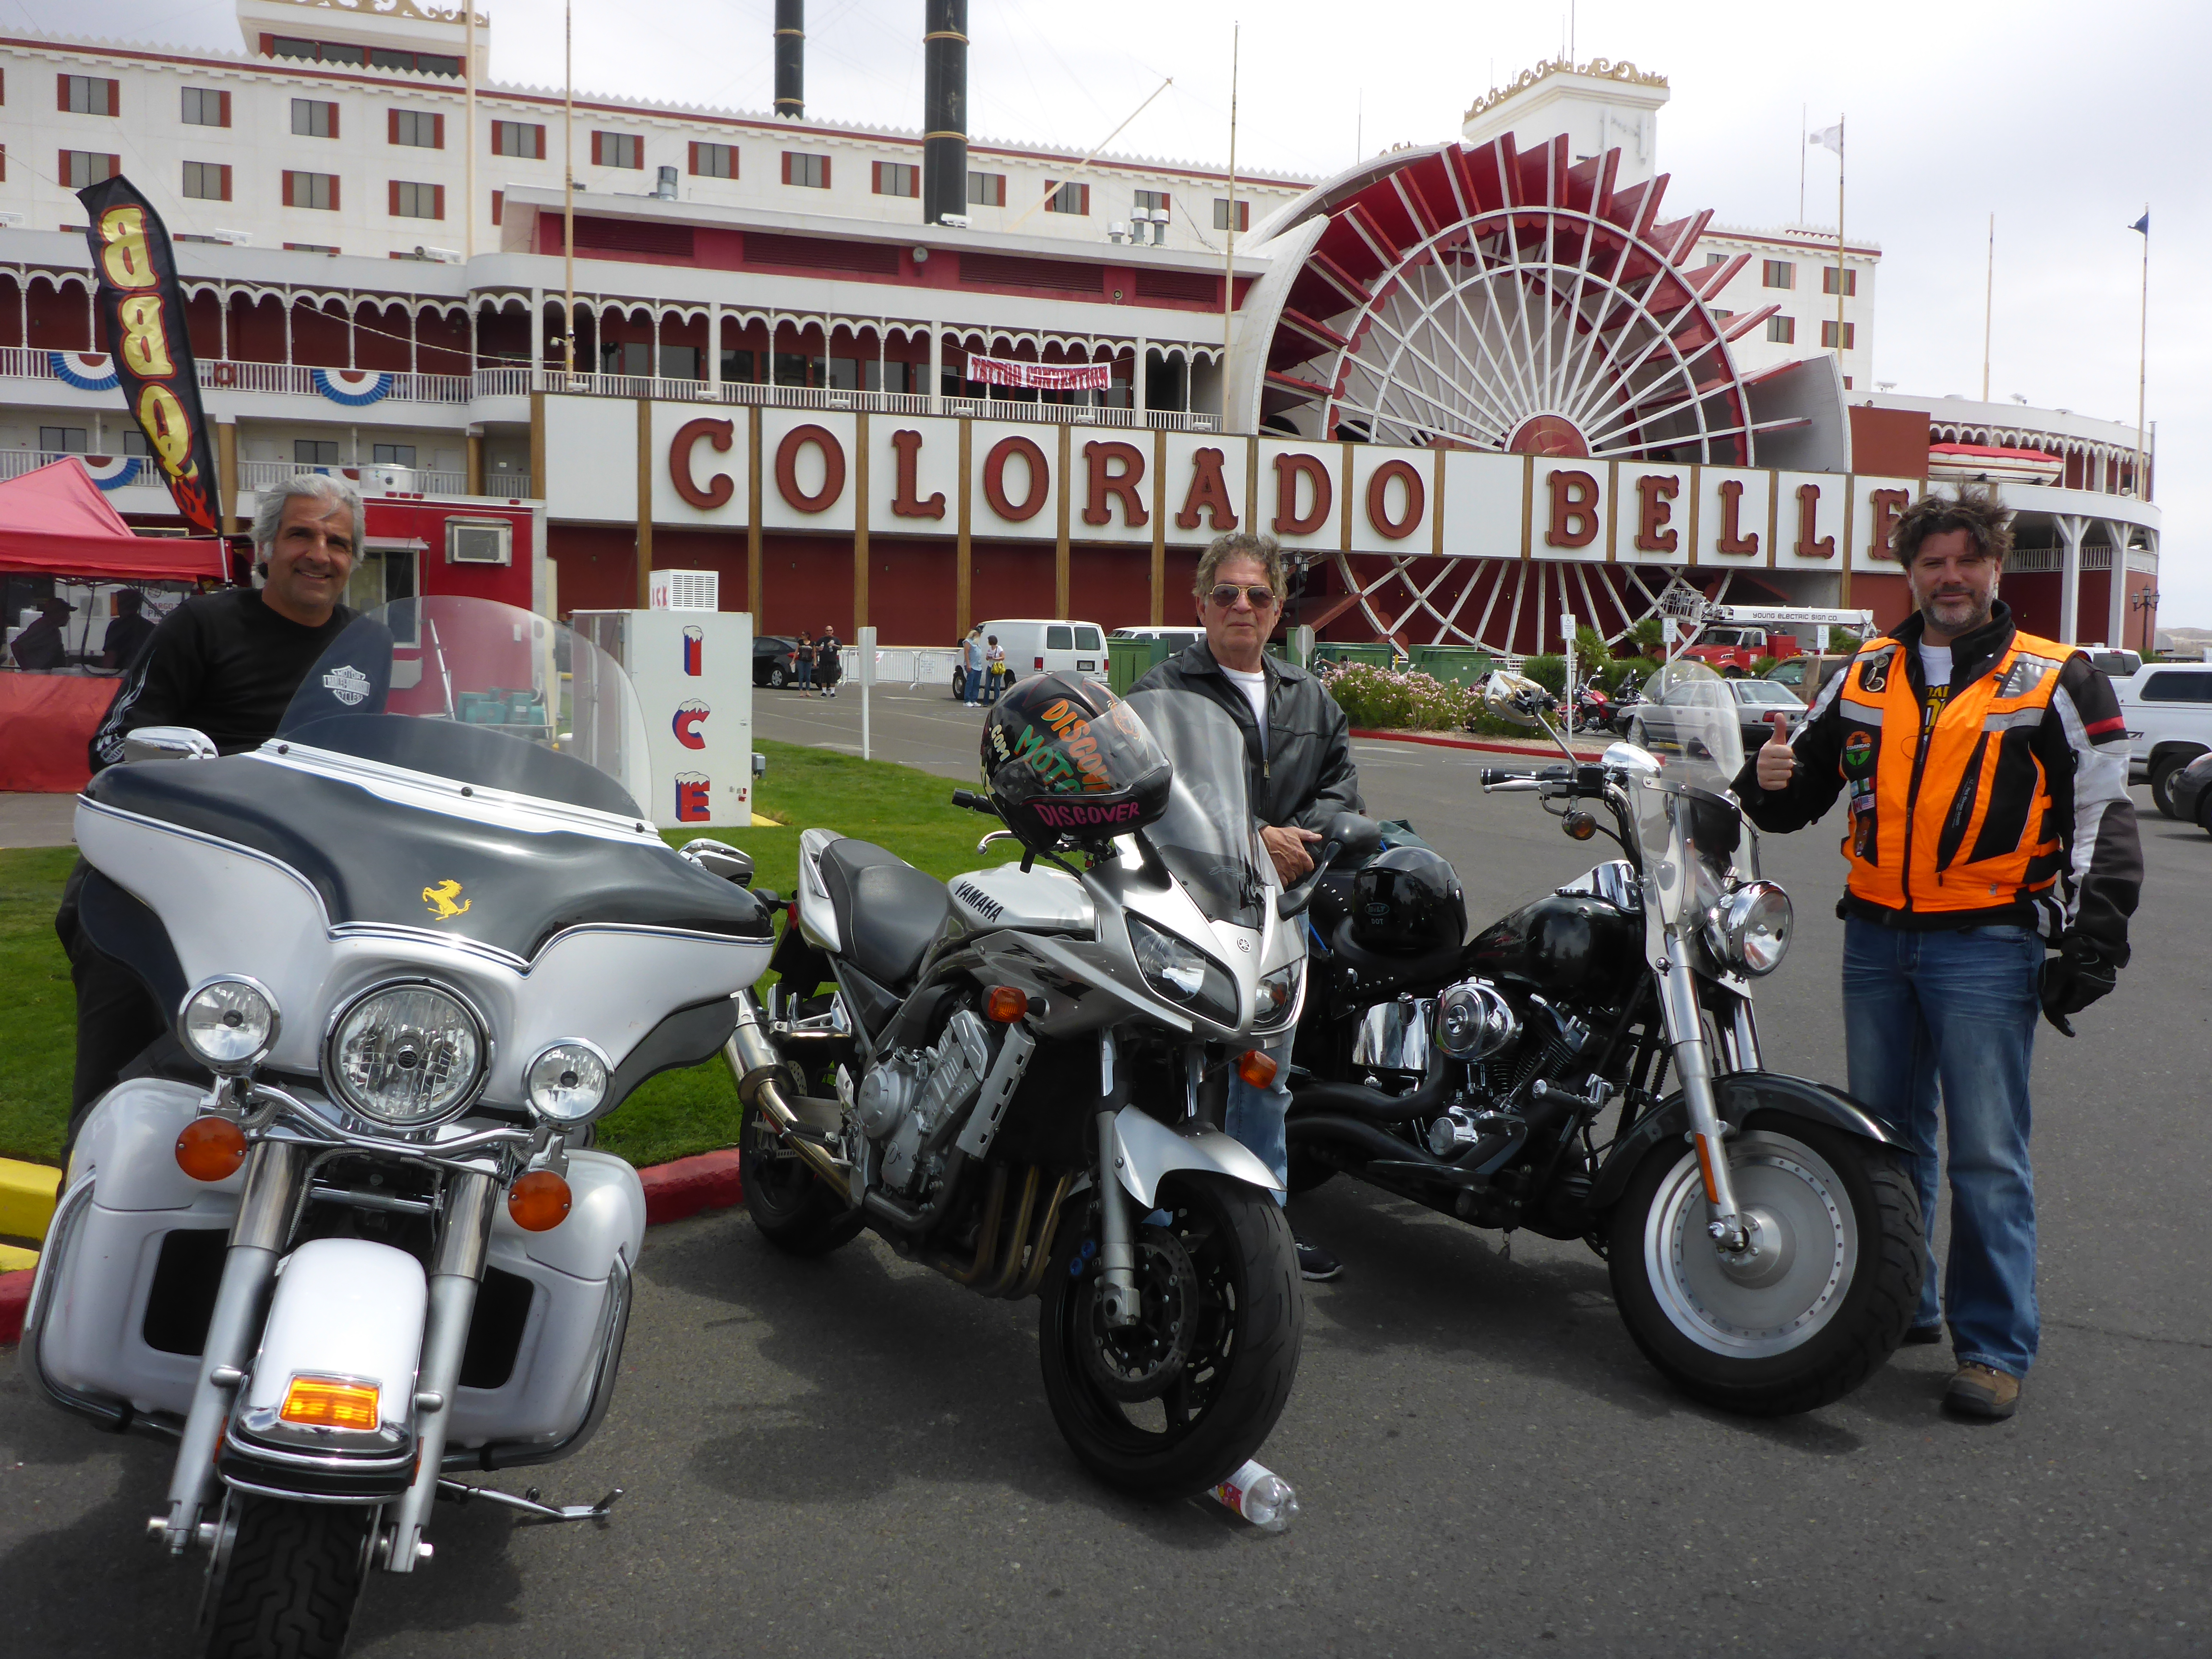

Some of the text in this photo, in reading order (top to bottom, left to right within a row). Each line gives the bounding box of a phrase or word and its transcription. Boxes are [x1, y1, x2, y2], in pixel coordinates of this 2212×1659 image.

[971, 357, 1108, 390] TATTOO CONVENTION
[670, 417, 1910, 561] COLORADO BELLE
[337, 690, 363, 703] CYCLES
[672, 625, 710, 822] ICE
[1034, 802, 1140, 827] DISCOVER
[954, 880, 1004, 923] YAMAHA
